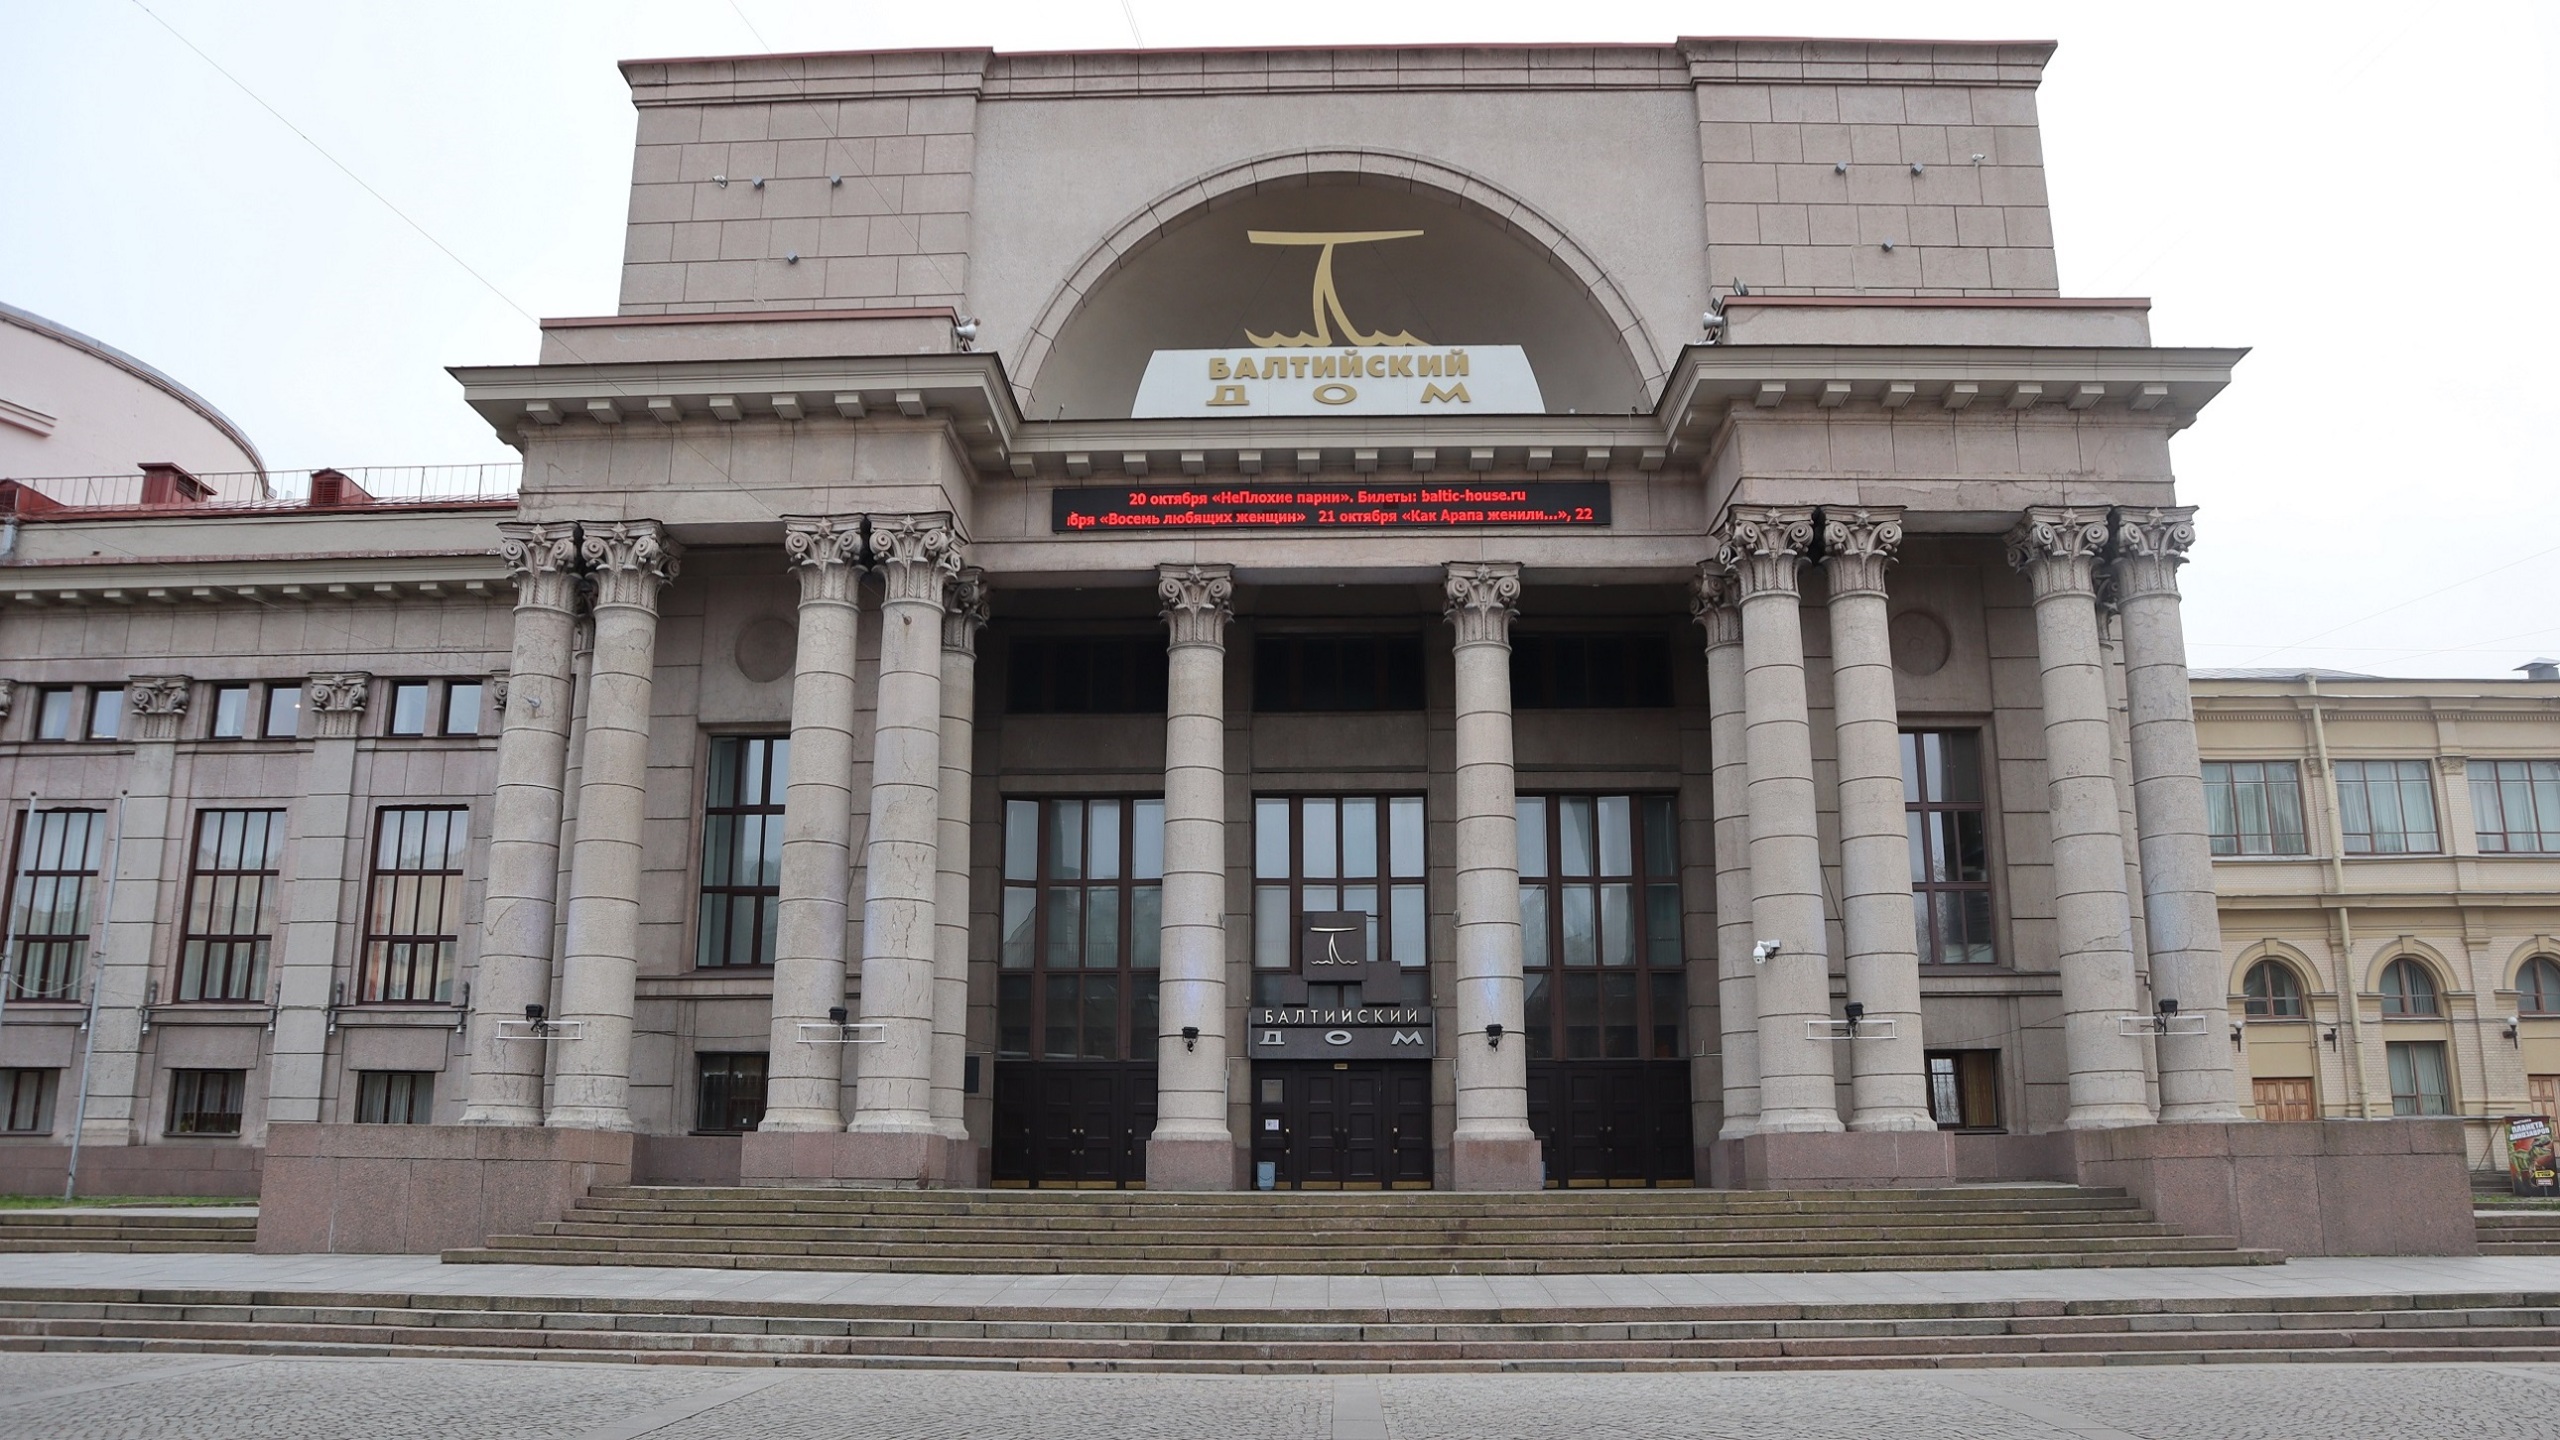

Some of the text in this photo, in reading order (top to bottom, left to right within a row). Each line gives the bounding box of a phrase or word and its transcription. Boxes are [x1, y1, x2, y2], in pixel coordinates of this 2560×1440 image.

[1208, 349, 1470, 380] БАЛТИЙСКИЙ
[1206, 381, 1472, 407] ДОМ
[1129, 489, 1527, 508] 20 октября «НеПлохие парни». Билеты: baltic-house.ru
[1100, 512, 1160, 526] «Восемь
[1162, 511, 1233, 527] любящих
[1235, 511, 1306, 526] женщин»
[1318, 510, 1336, 523] 21
[1339, 509, 1398, 526] октября
[1402, 509, 1437, 523] «Как
[1440, 508, 1484, 524] Арапа
[1575, 507, 1594, 521] 22
[1265, 1008, 1419, 1024] БАЛТИЙСКИЙ
[1259, 1030, 1425, 1046] ДОМ
[2511, 1120, 2544, 1134] ПЛАНЕТА
